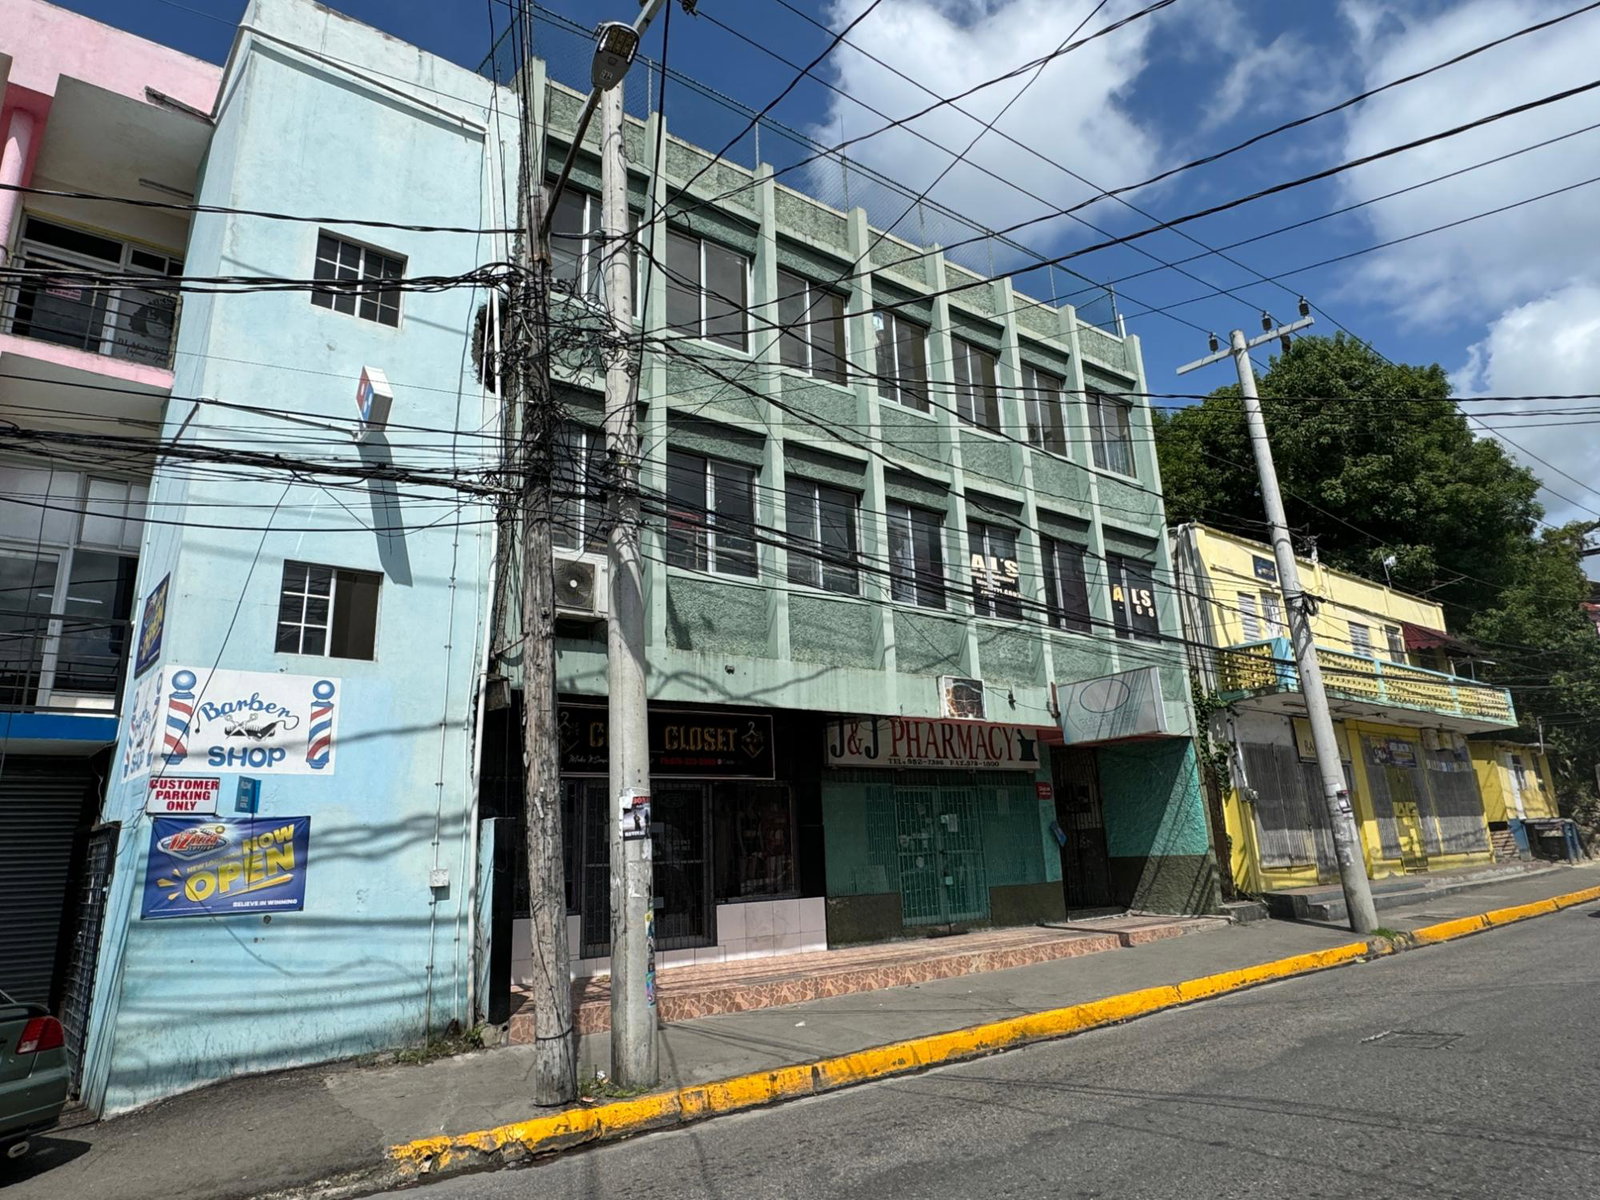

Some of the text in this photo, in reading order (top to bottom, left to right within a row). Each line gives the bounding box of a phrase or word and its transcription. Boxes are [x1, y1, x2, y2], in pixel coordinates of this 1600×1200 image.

[201, 692, 292, 722] Barber
[664, 725, 738, 752] CLOSET
[830, 717, 1016, 761] J&J PHARMACY
[208, 746, 286, 767] SHOP
[149, 779, 219, 791] CUSTOMER
[155, 790, 211, 801] PARKING
[166, 801, 198, 811] ONLY
[242, 824, 295, 854] NOW
[184, 841, 296, 902] OPEN
